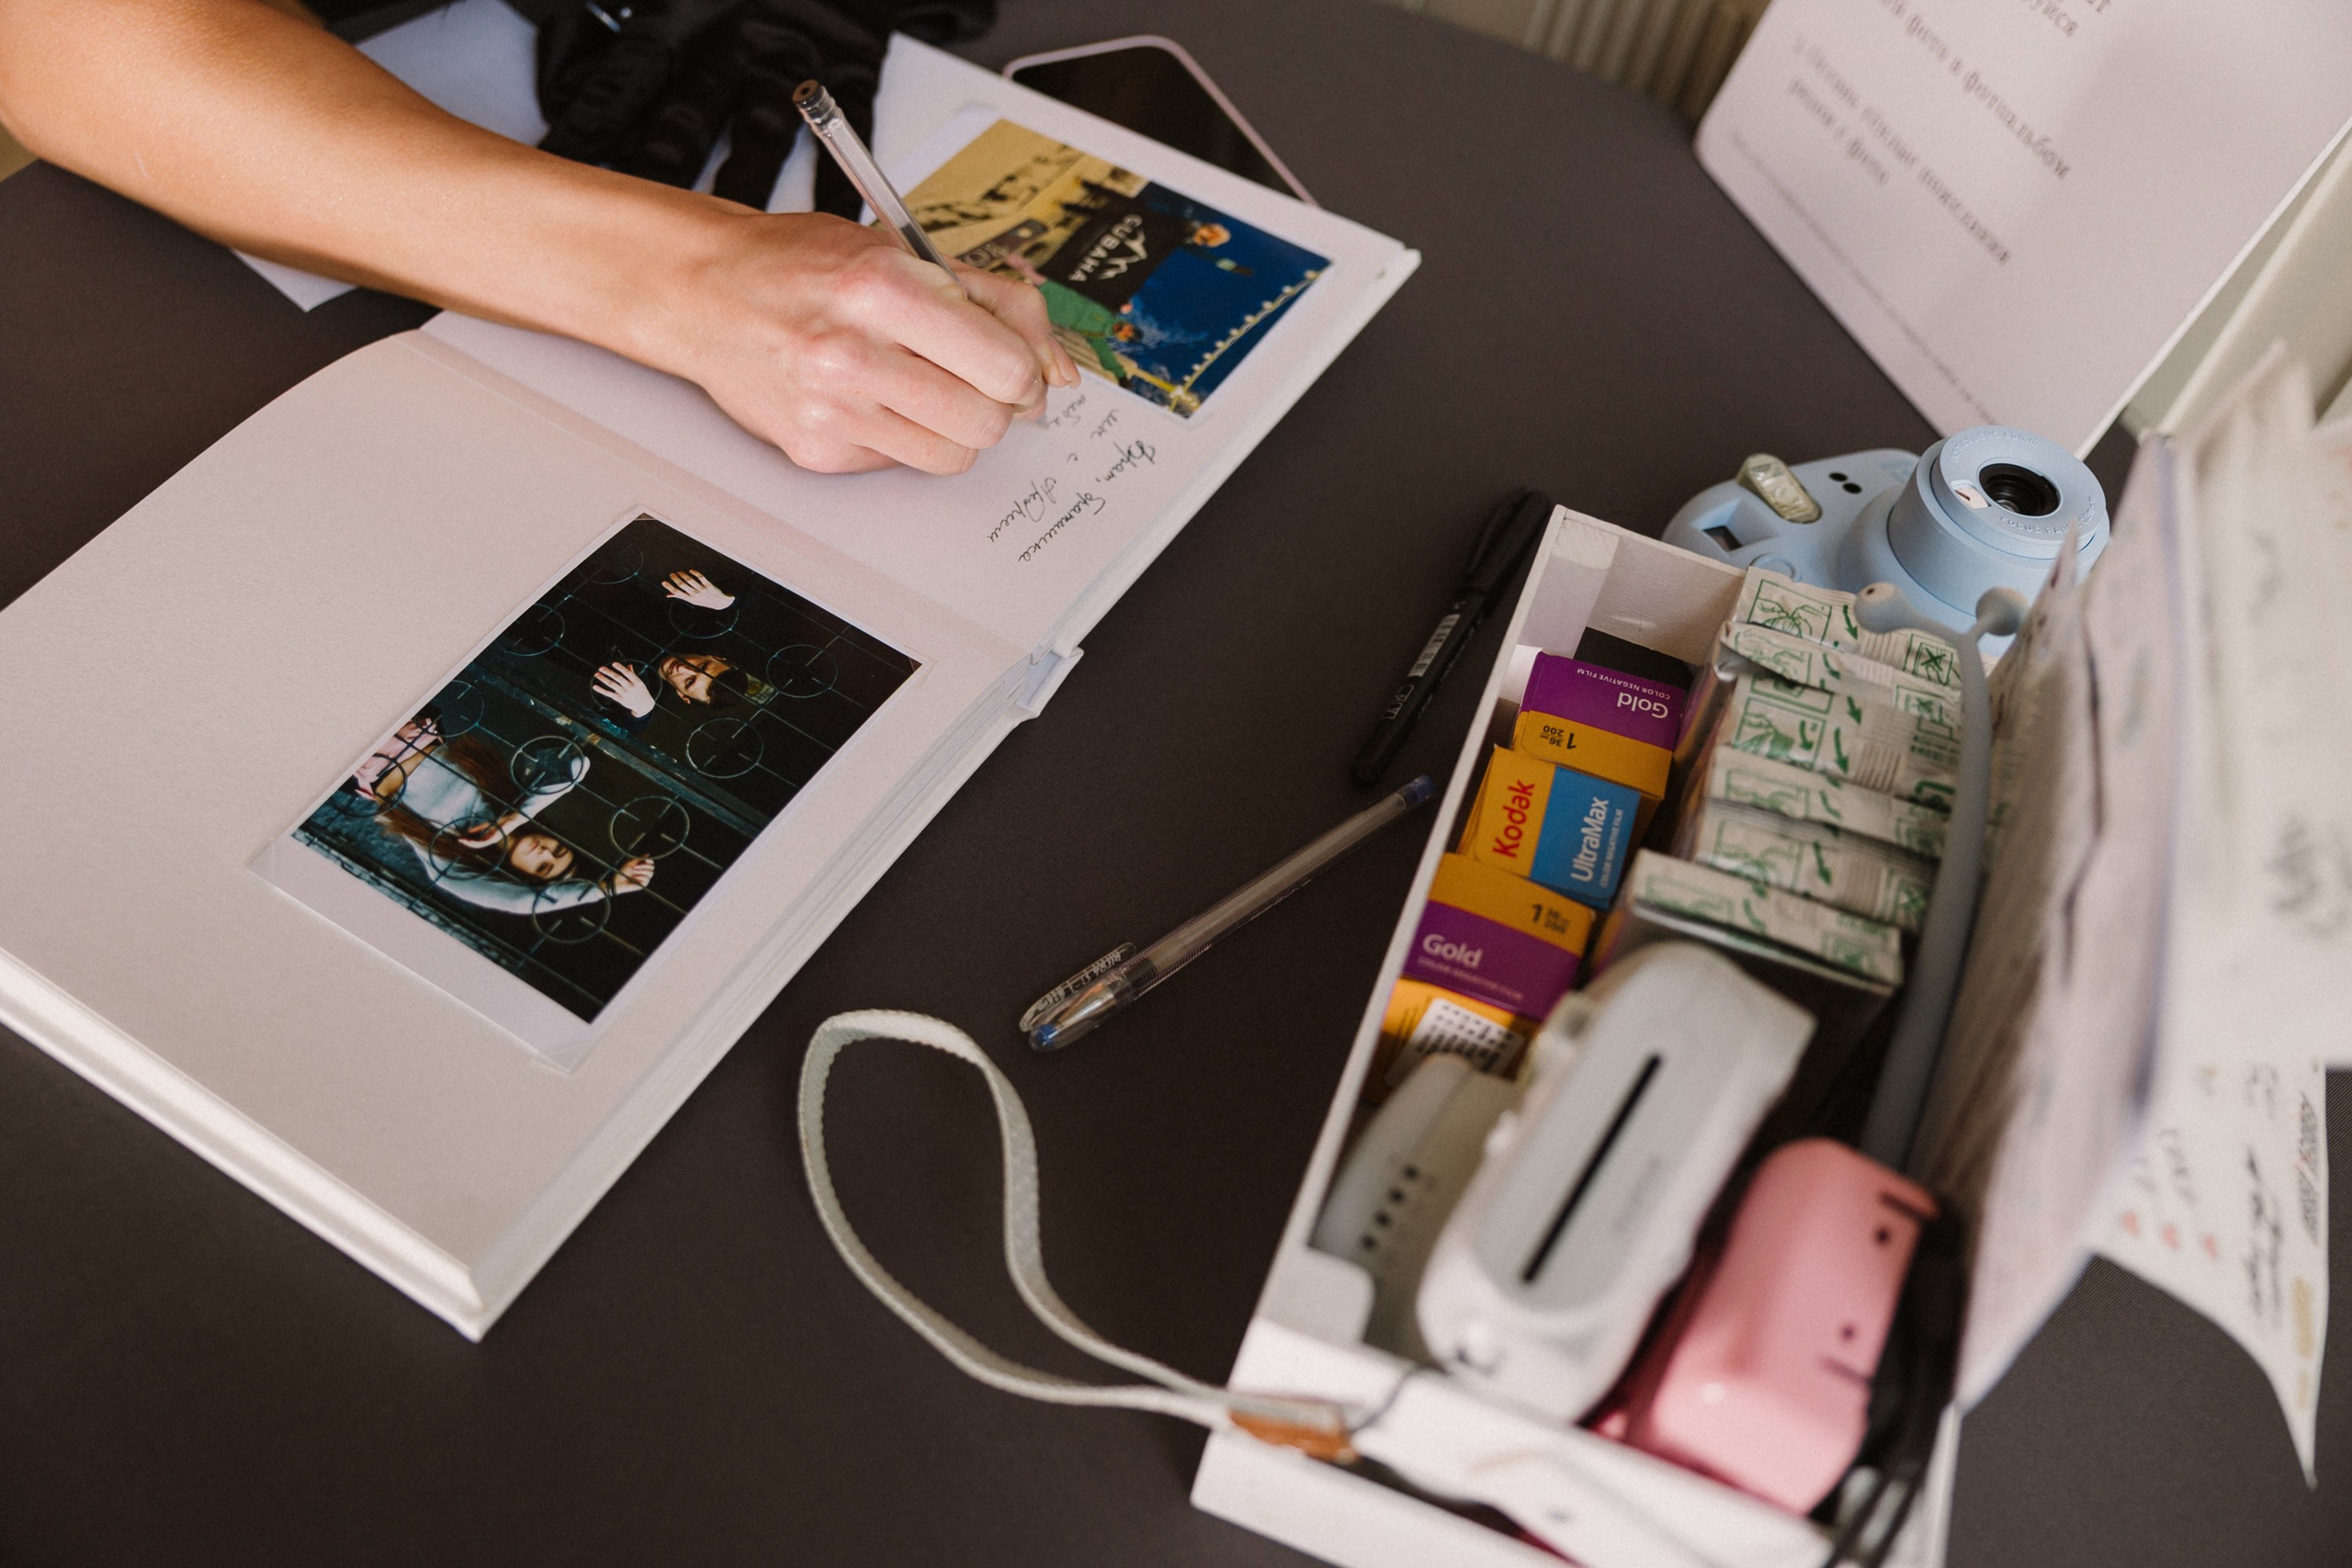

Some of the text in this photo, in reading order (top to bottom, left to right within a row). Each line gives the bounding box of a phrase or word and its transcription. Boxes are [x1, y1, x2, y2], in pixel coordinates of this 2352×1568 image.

[1962, 71, 2070, 180] фотоальбом
[2000, 515, 2041, 535] FOCUS
[1577, 667, 1671, 700] COLOR NEGATIVE FILM
[1616, 692, 1669, 719] Gold
[1543, 725, 1565, 738] 200
[1566, 732, 1577, 750] 1
[1492, 780, 1535, 859] Kodak
[1570, 796, 1610, 883] UltraMax
[1422, 933, 1484, 969] Gold
